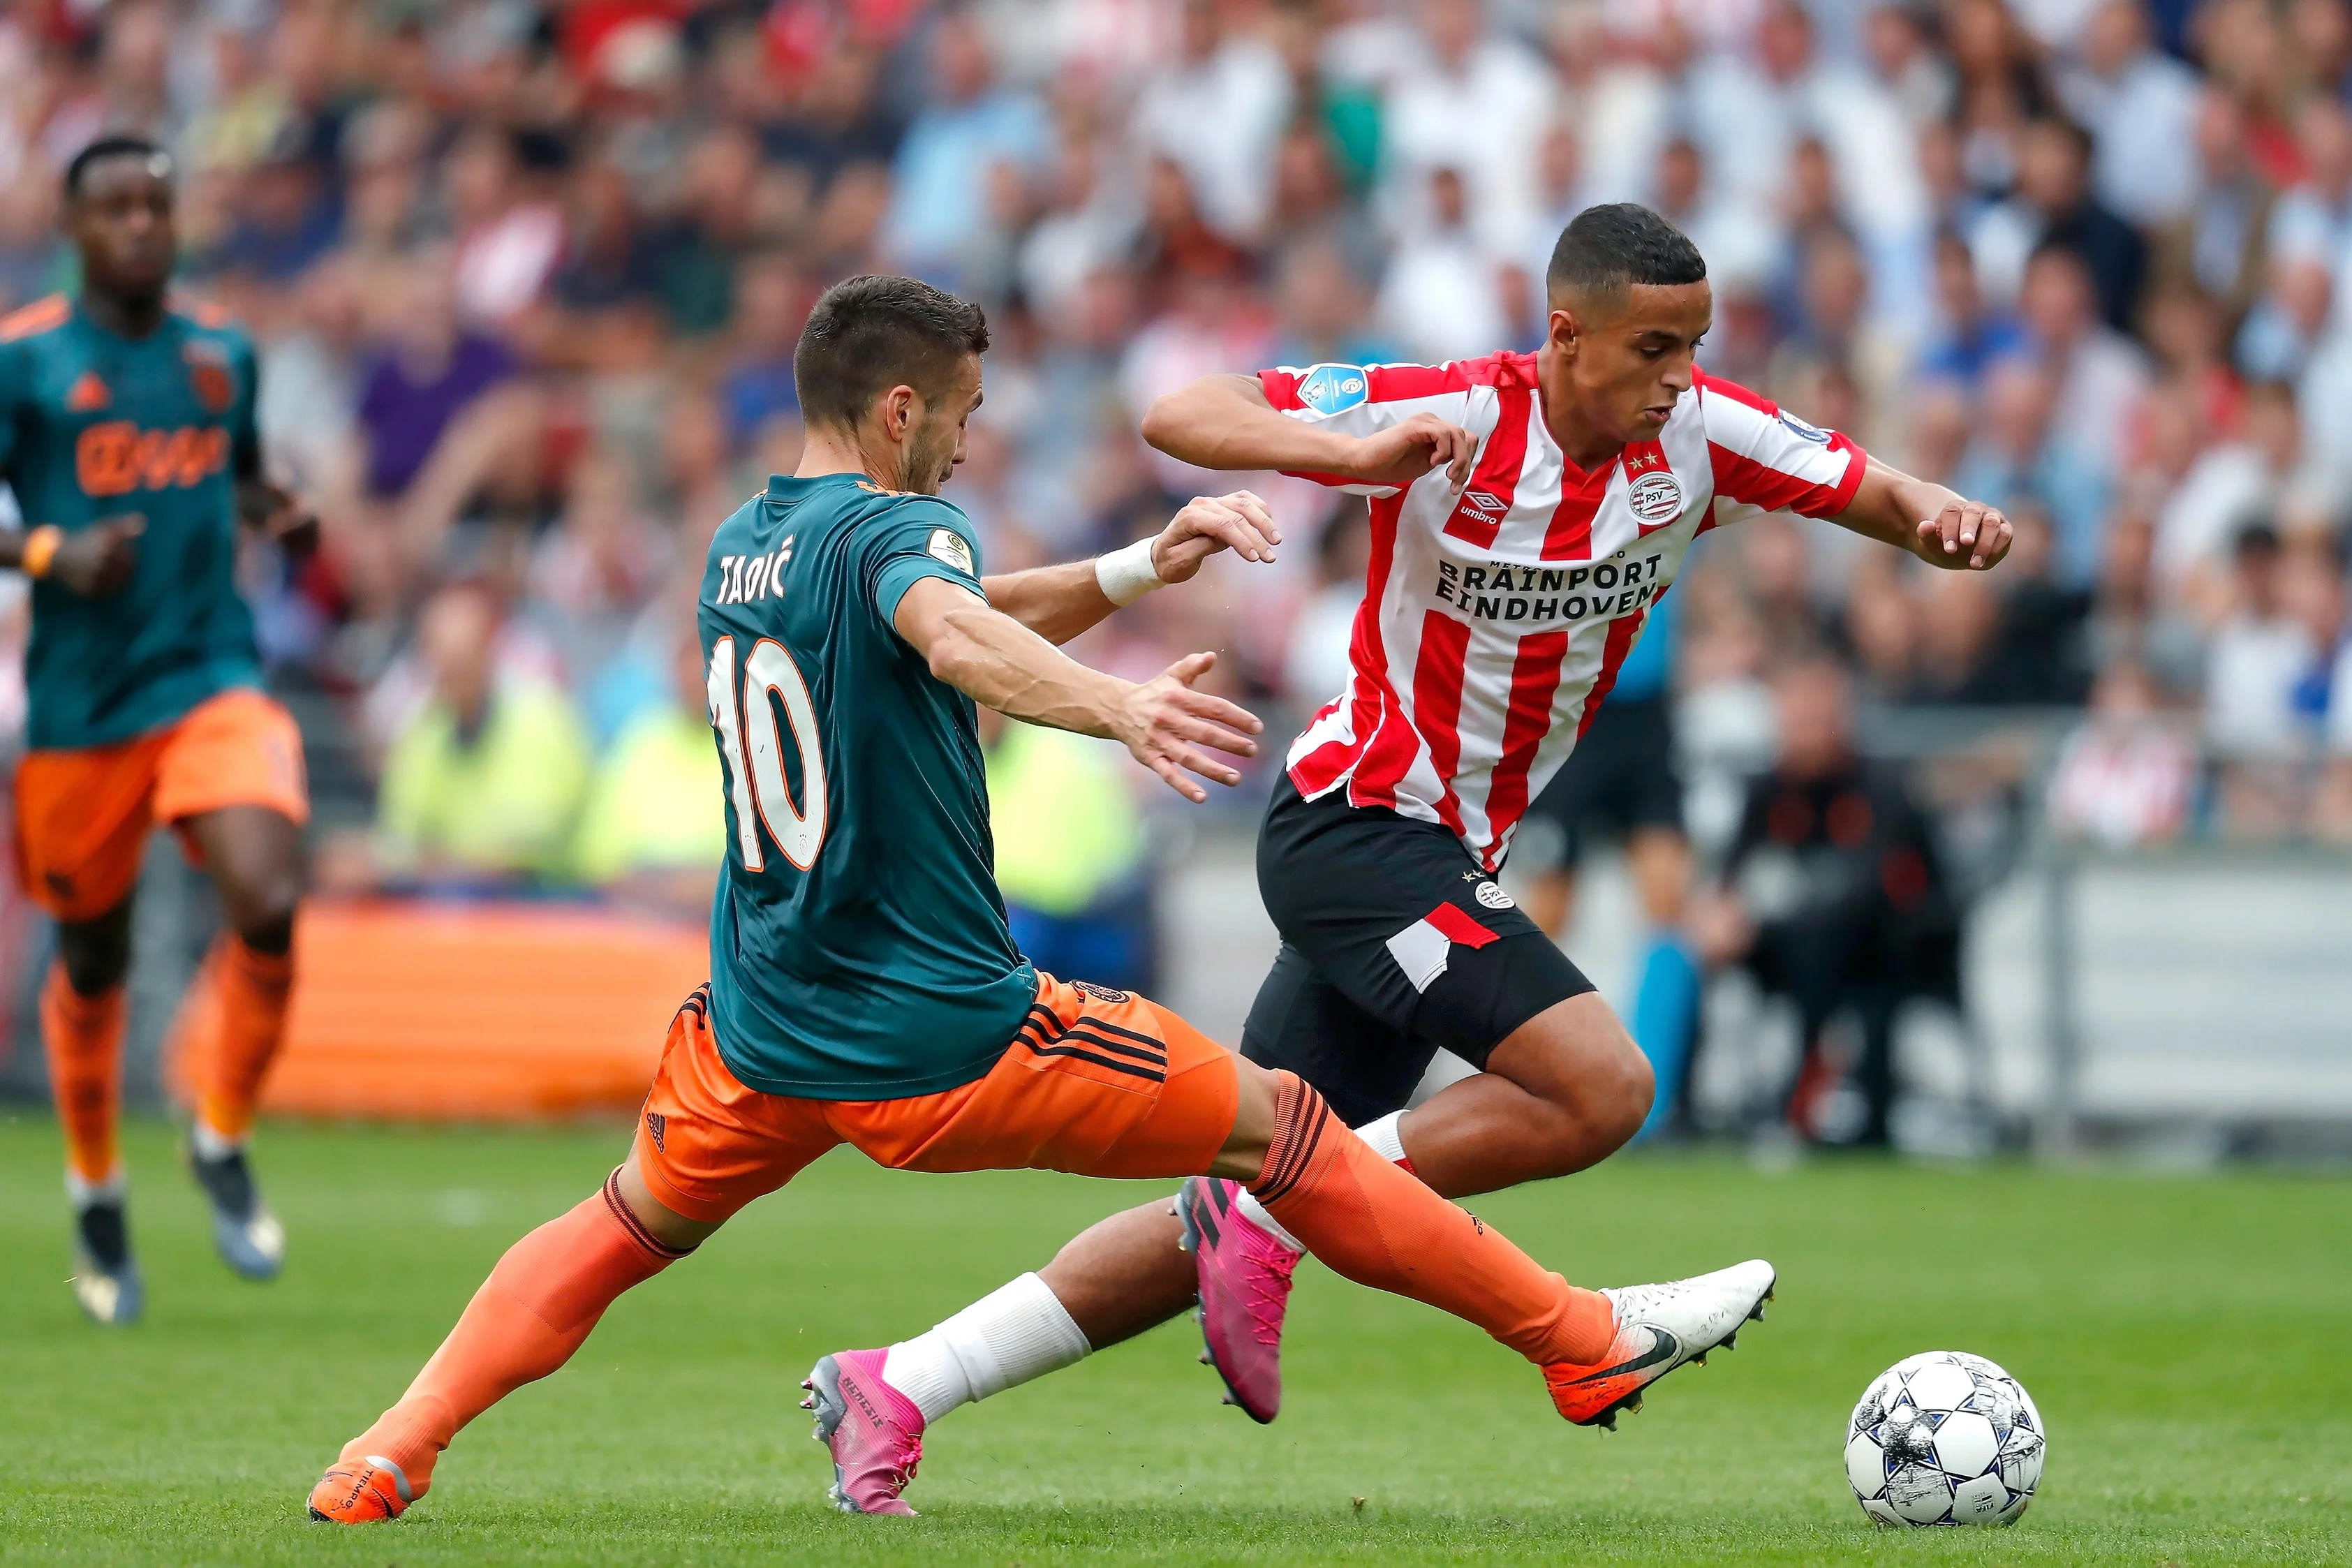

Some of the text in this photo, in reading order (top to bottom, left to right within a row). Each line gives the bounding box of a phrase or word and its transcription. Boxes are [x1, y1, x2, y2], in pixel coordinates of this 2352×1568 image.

[1460, 506, 1497, 524] umbro
[1645, 491, 1664, 503] PSV
[716, 534, 793, 605] TADIĆ
[1439, 554, 1662, 592] BRAINPORT
[1435, 577, 1657, 620] EINDHOVEN
[707, 635, 829, 873] 10
[843, 1376, 884, 1428] NEMESIS
[346, 1470, 374, 1508] TIEMPO
